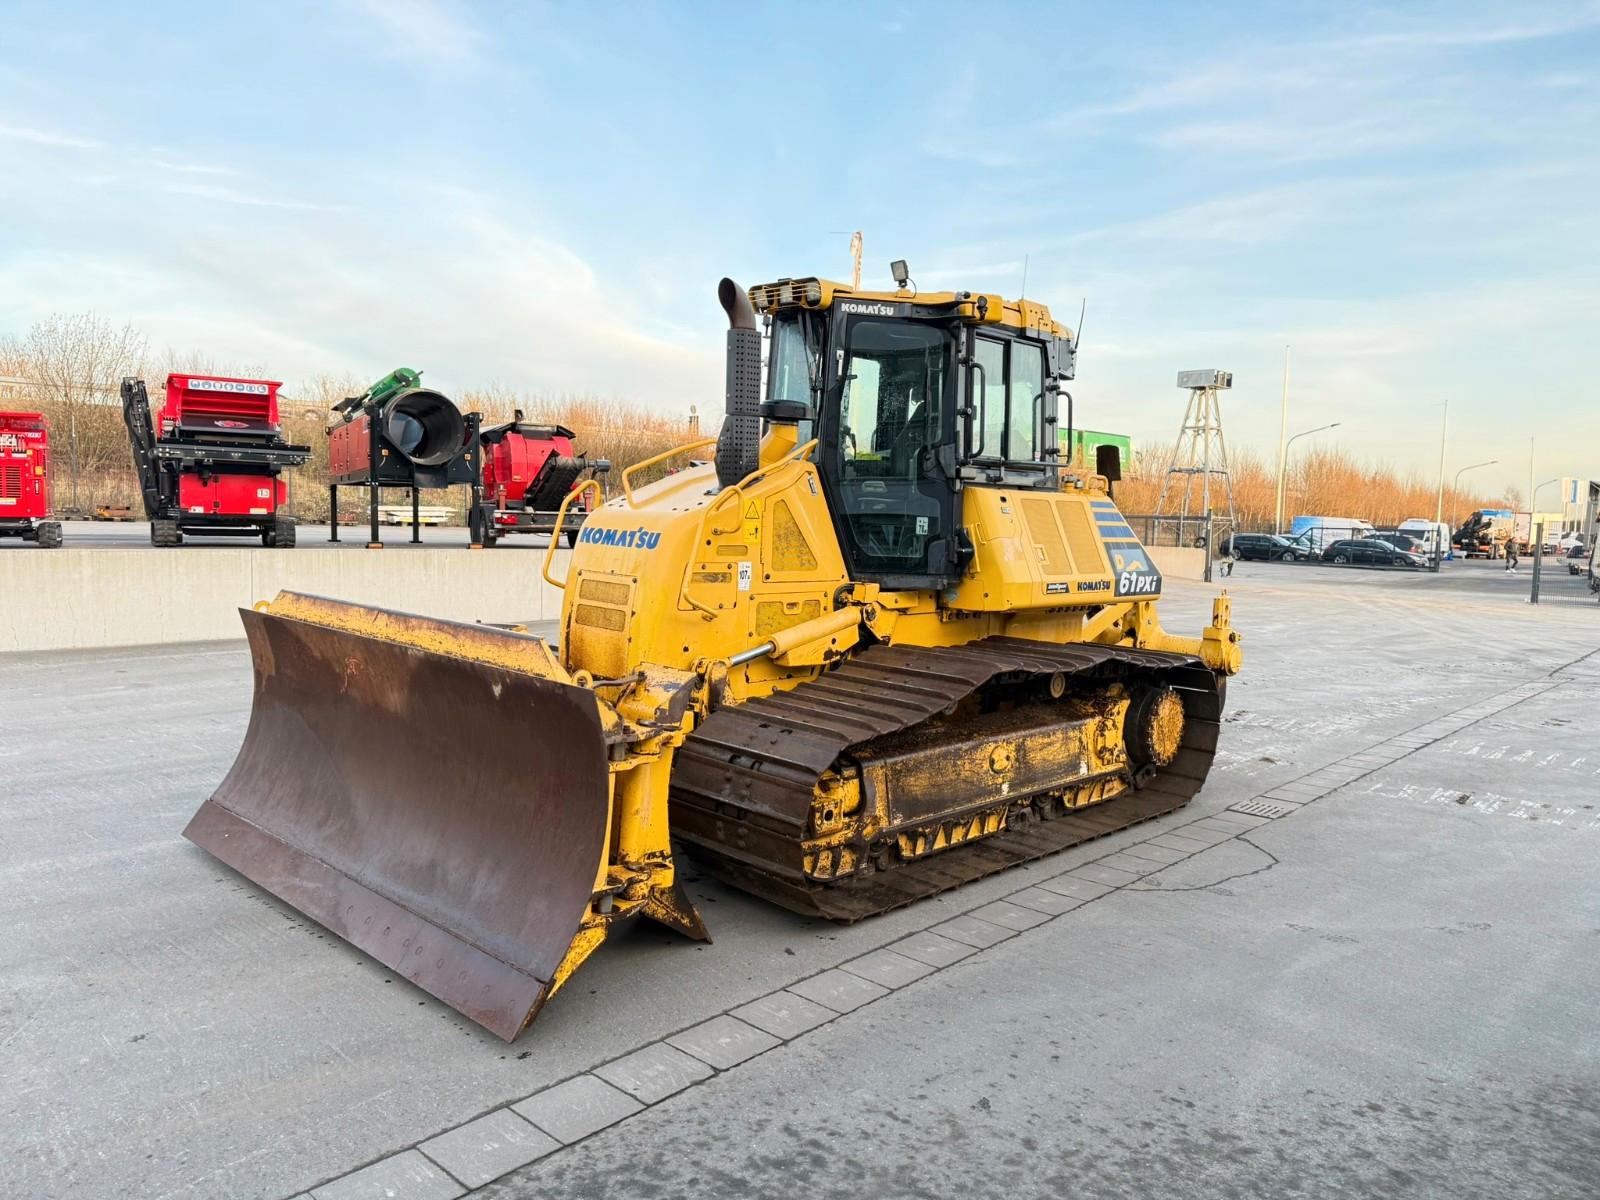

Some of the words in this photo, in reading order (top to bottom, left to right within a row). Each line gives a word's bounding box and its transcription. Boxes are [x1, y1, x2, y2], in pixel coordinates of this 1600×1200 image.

[841, 303, 893, 315] KOMATSU
[579, 527, 661, 549] KOMATSU
[1077, 579, 1110, 591] KOMATSU
